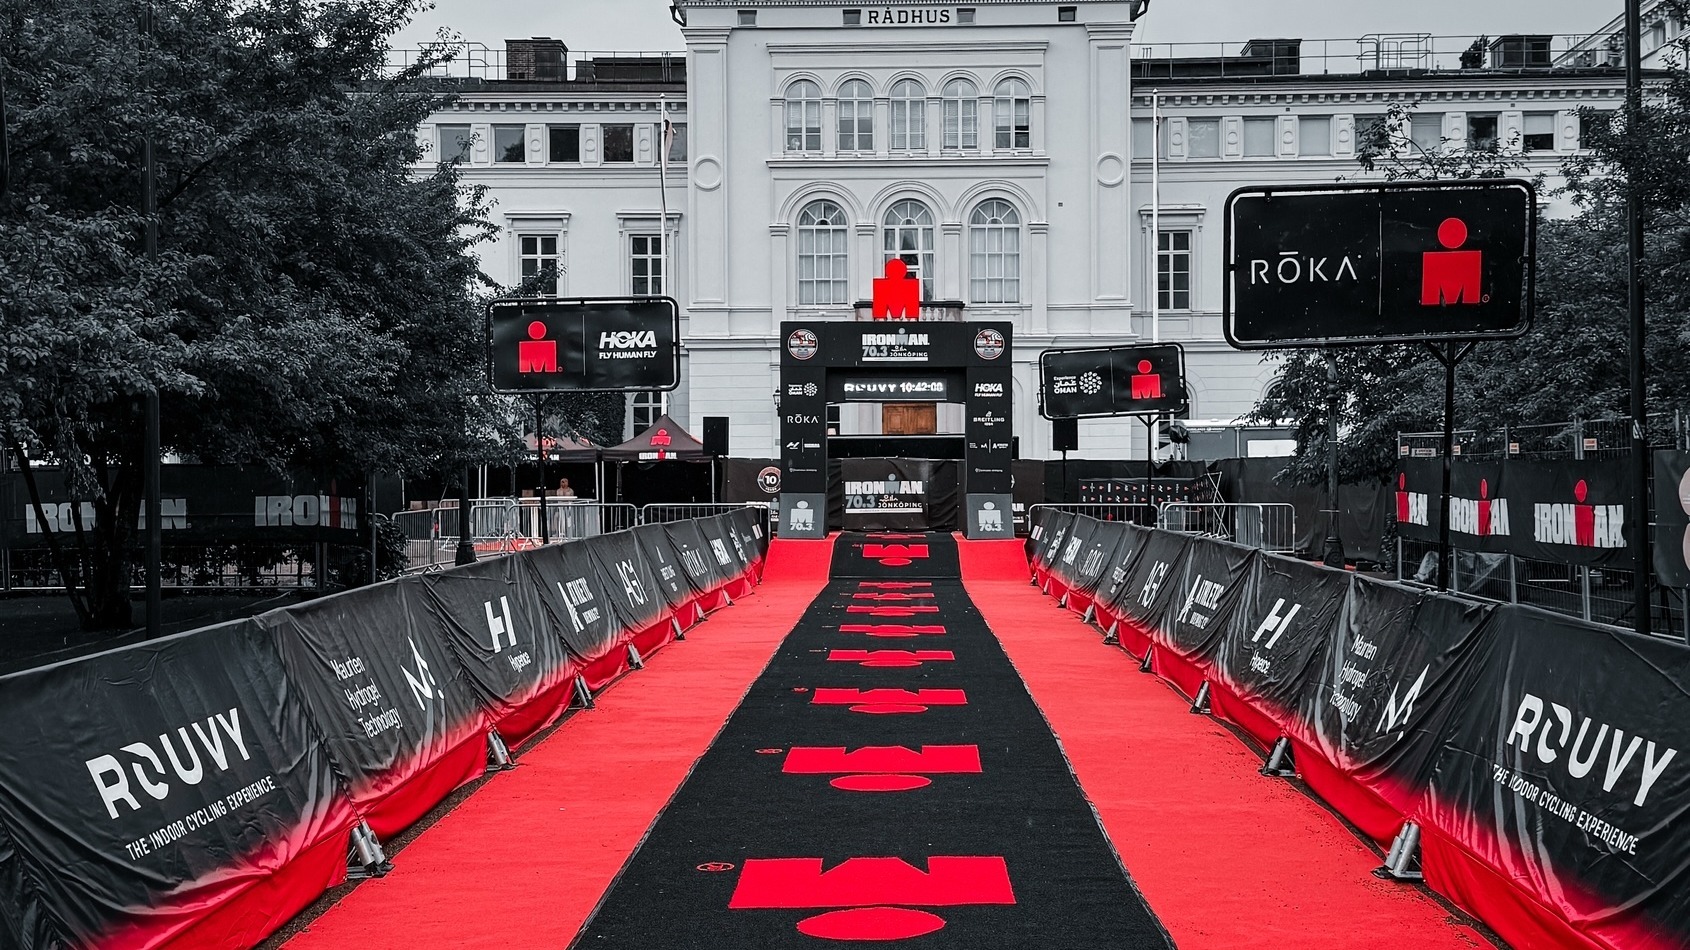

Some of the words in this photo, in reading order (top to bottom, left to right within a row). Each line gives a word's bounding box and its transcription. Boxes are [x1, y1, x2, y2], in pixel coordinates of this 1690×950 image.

[867, 6, 950, 24] RÅDHUS
[598, 330, 658, 349] HOKA
[861, 333, 929, 346] IRONMAN
[598, 351, 612, 360] FLY
[612, 351, 643, 359] HUMAN
[643, 350, 658, 359] FLY
[862, 345, 889, 357] 70.3
[974, 382, 1004, 393] HOKA
[1053, 386, 1078, 395] OMAN
[764, 475, 778, 486] 10
[844, 480, 925, 495] IRONMAN
[845, 495, 877, 509] 70.3
[789, 522, 814, 531] 70.3
[979, 523, 1004, 532] 70.3
[1533, 502, 1627, 549] IRONMAN
[329, 655, 366, 681] Maurten
[343, 677, 382, 714] Hydrogel
[357, 706, 403, 739] Technology
[1506, 692, 1678, 808] ROUVY
[85, 706, 251, 821] ROUVY
[1492, 763, 1510, 785] THE
[1538, 790, 1578, 824] CYCLING
[1575, 810, 1640, 856] EXPERIENCE
[125, 837, 151, 861] THE
[149, 819, 188, 850] INDOOR
[185, 799, 228, 832] CYCLING
[226, 775, 276, 811] EXPERIENCE
